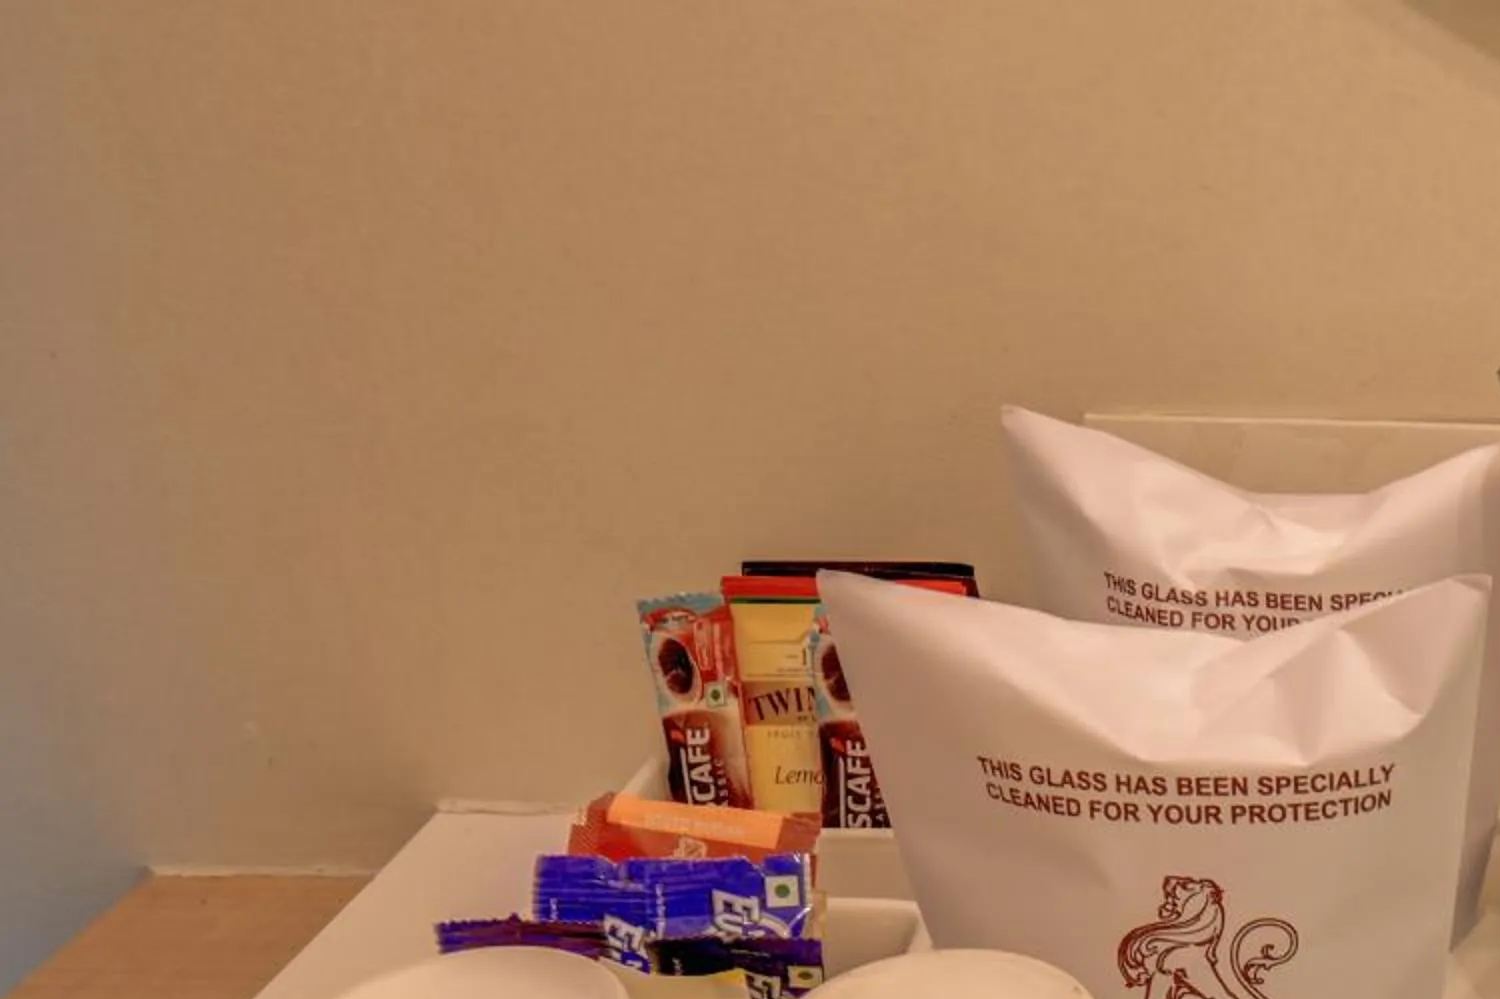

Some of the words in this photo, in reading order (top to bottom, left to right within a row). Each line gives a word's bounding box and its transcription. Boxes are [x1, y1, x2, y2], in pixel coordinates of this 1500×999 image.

[1104, 571, 1136, 596] THIS
[1141, 583, 1208, 607] GLASS
[1215, 591, 1259, 608] HAS
[1266, 592, 1323, 612] BEEN
[1107, 596, 1184, 628] CLEANED
[1190, 611, 1236, 631] FOR
[977, 756, 1023, 782] THIS
[1029, 766, 1107, 793] GLASS
[1115, 774, 1168, 796] HAS
[1176, 776, 1249, 797] BEEN
[1257, 763, 1395, 797] SPECIALLY
[985, 782, 1081, 818] CLEANED
[1089, 800, 1141, 823] FOR
[1146, 803, 1223, 825] YOUR
[1230, 789, 1392, 825] PROTECTION
